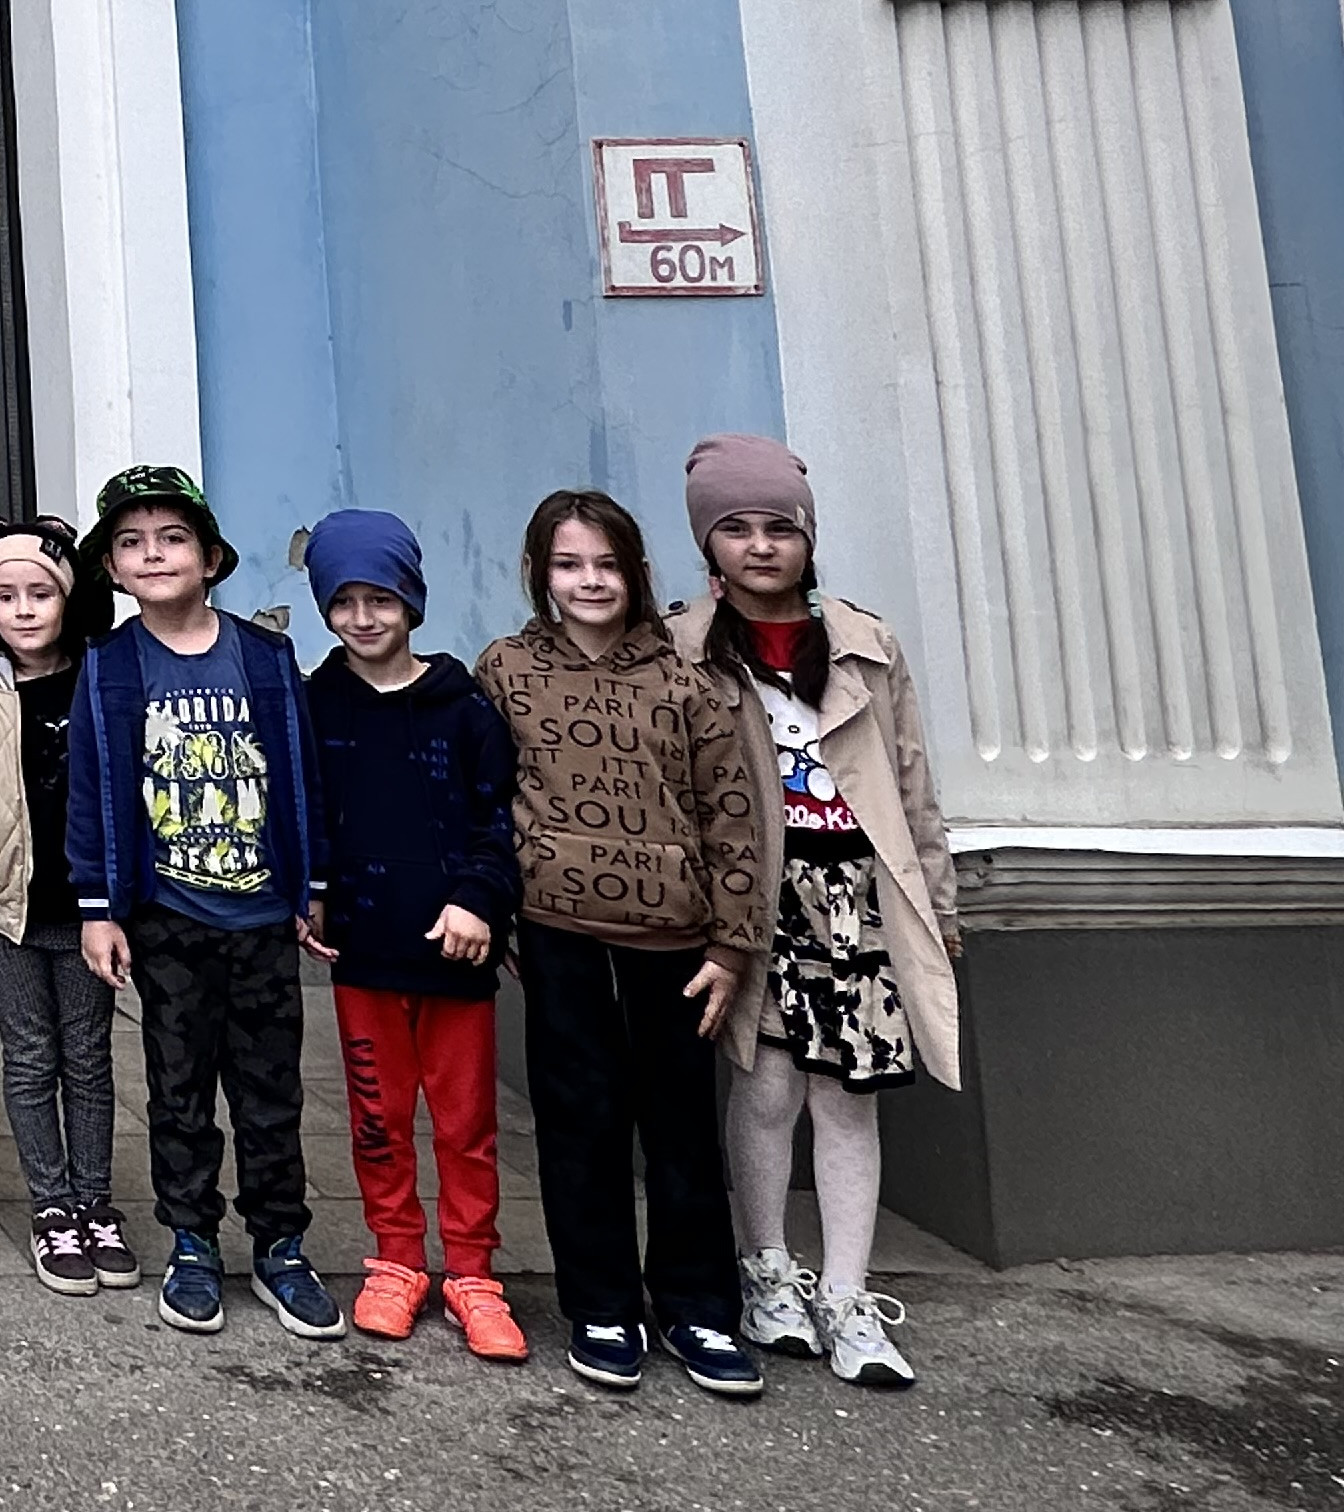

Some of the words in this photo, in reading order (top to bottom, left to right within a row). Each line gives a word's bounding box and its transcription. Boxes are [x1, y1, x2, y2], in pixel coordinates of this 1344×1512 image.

[564, 695, 634, 719] PARI
[540, 717, 640, 753] SOU
[571, 773, 641, 800] PARI
[548, 796, 648, 836] SOU
[562, 867, 666, 908] SOU
